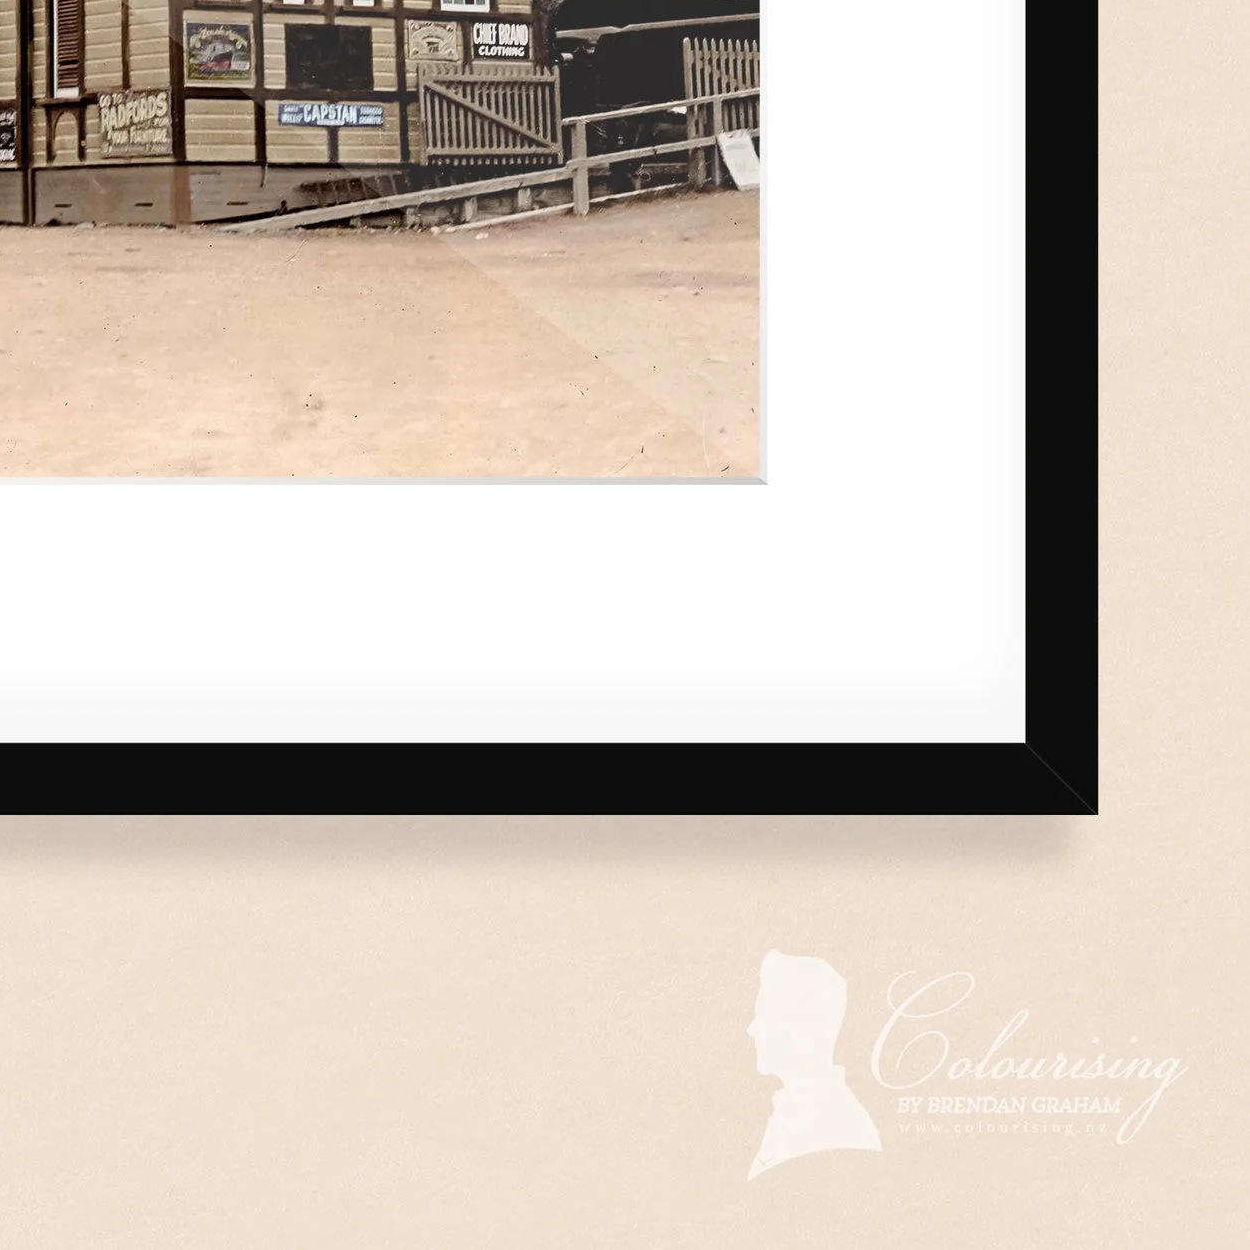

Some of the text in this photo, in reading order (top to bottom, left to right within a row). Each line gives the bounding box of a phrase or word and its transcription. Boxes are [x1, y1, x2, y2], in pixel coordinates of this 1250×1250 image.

[498, 23, 529, 46] BRAND
[478, 45, 525, 57] CLOTHING
[303, 104, 358, 124] CAPSTAN
